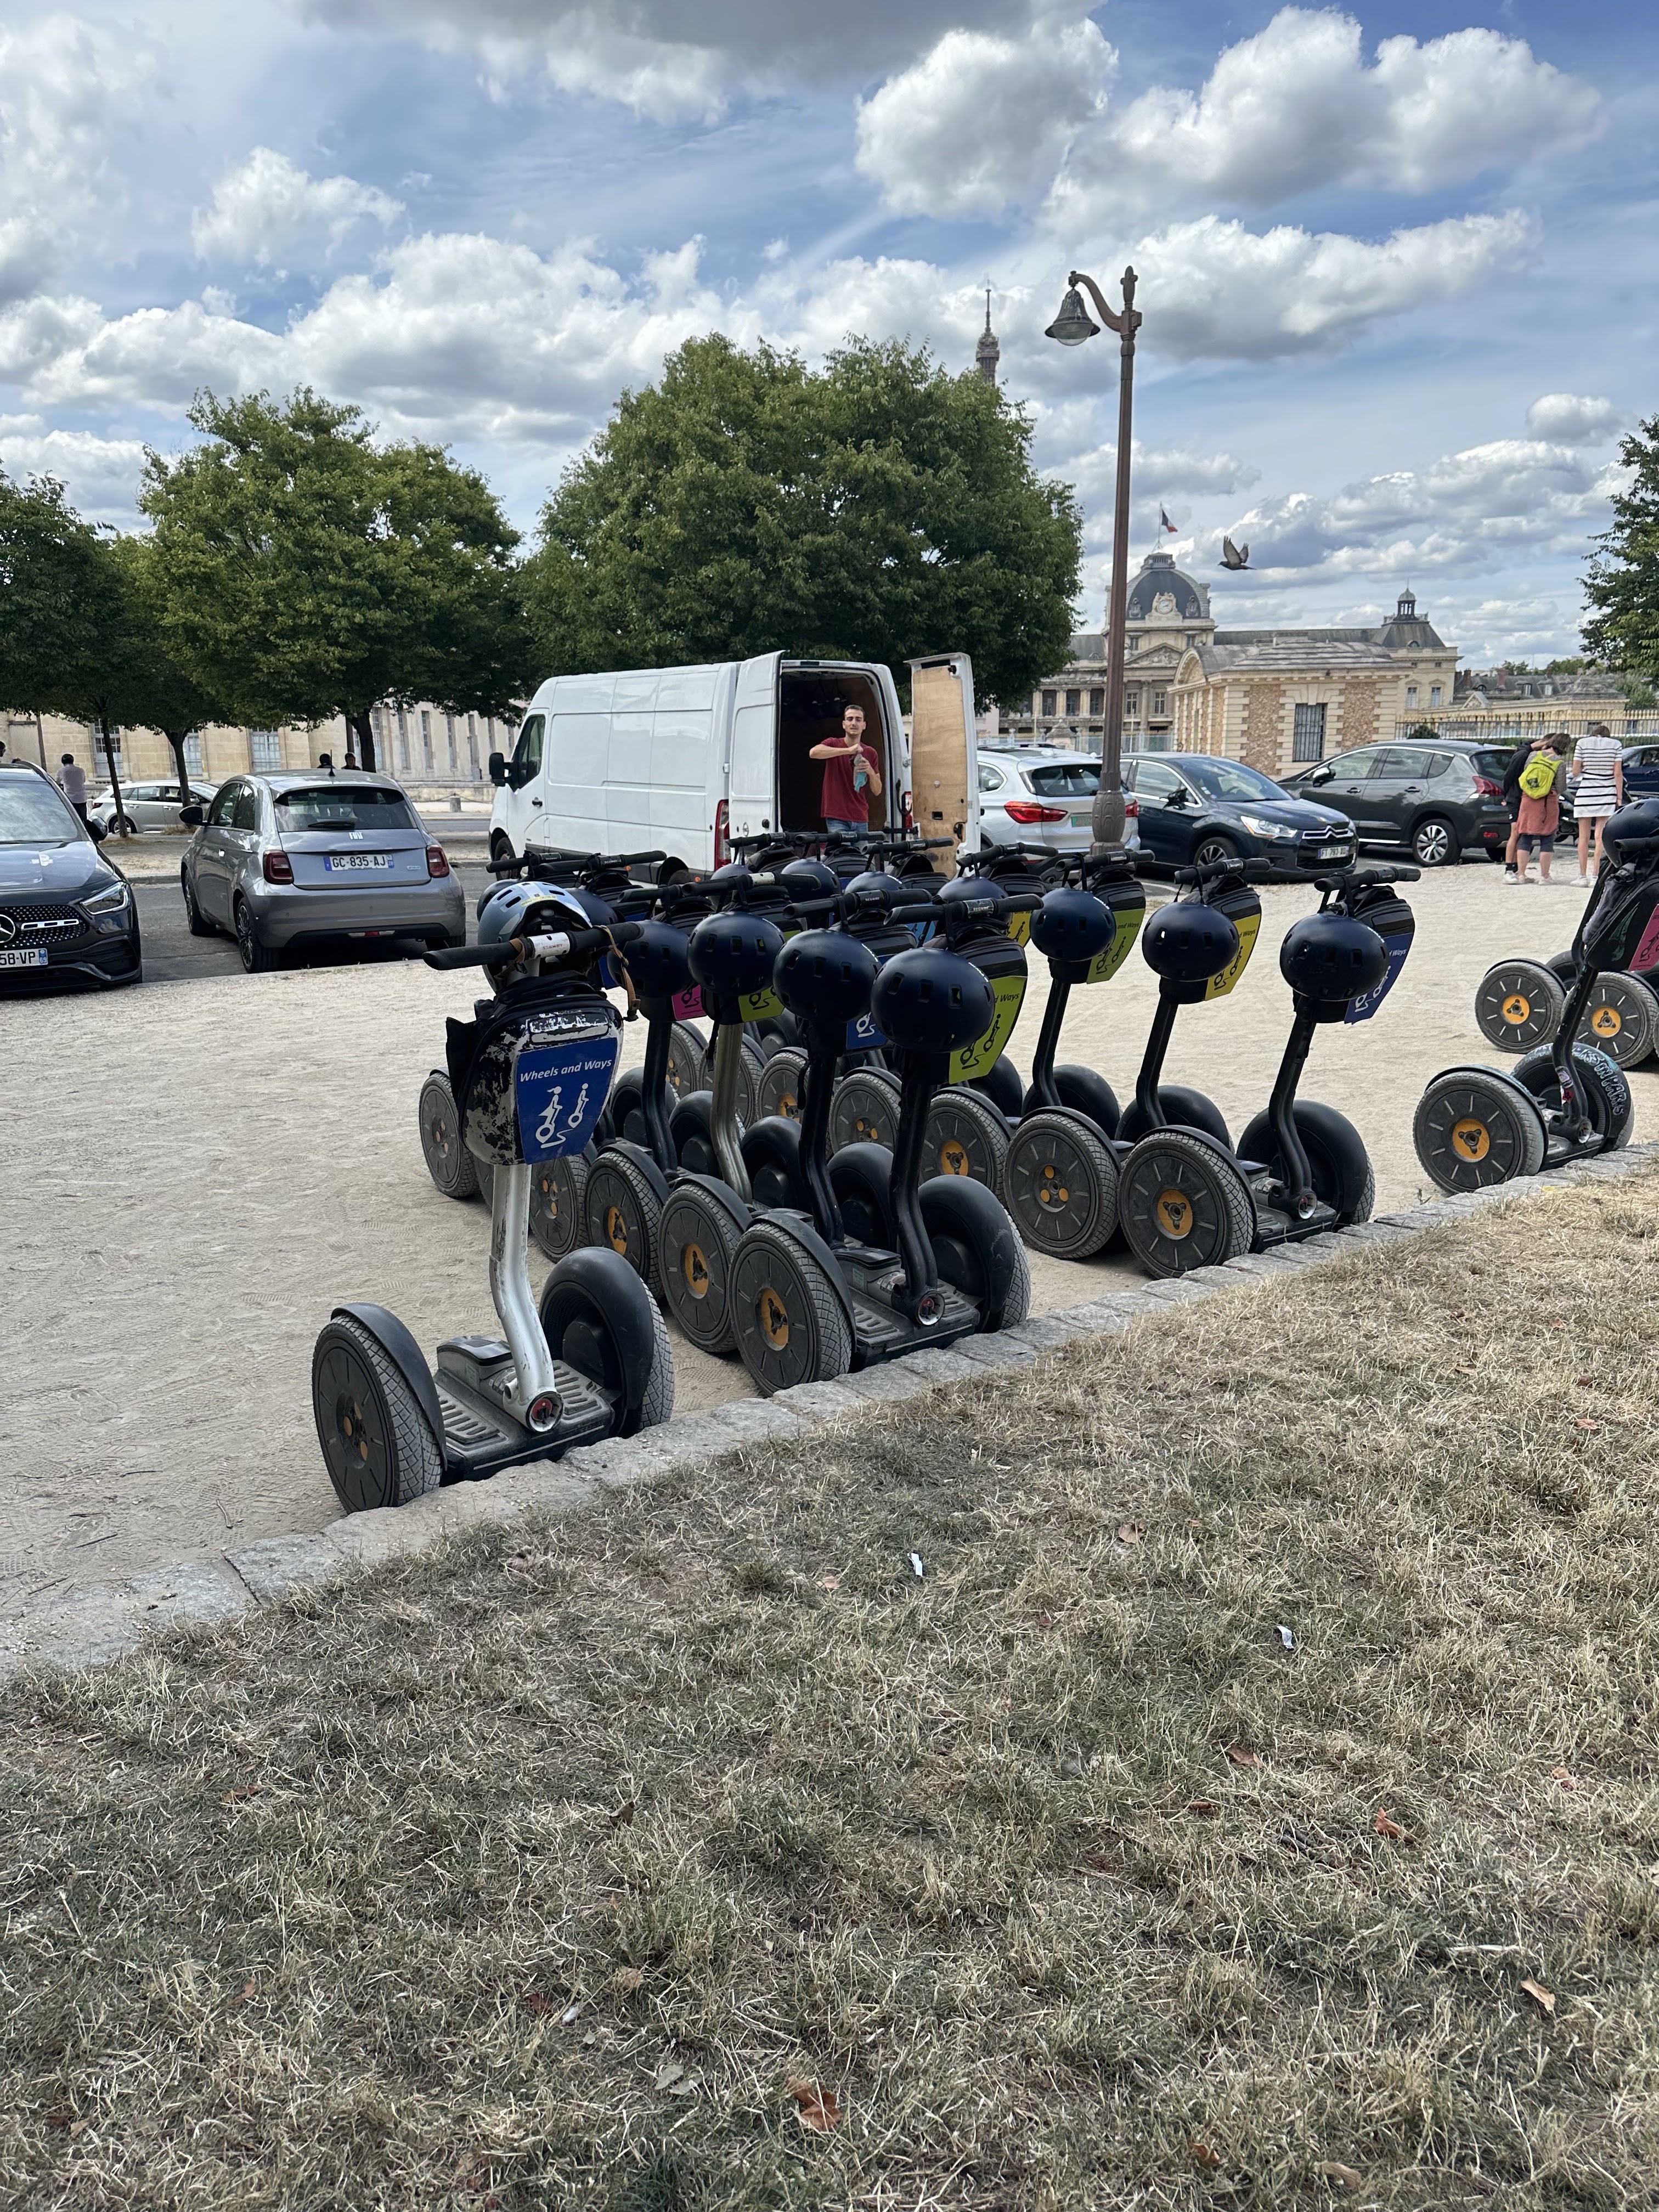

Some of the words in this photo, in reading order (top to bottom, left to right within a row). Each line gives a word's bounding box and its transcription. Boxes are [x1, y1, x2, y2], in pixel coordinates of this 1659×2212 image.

[349, 832, 363, 840] FIAT
[332, 856, 386, 868] GC-835-AJ
[1000, 993, 1020, 1002] Ways
[520, 1066, 558, 1082] Wheels
[561, 1062, 582, 1075] and
[584, 1059, 613, 1070] Ways
